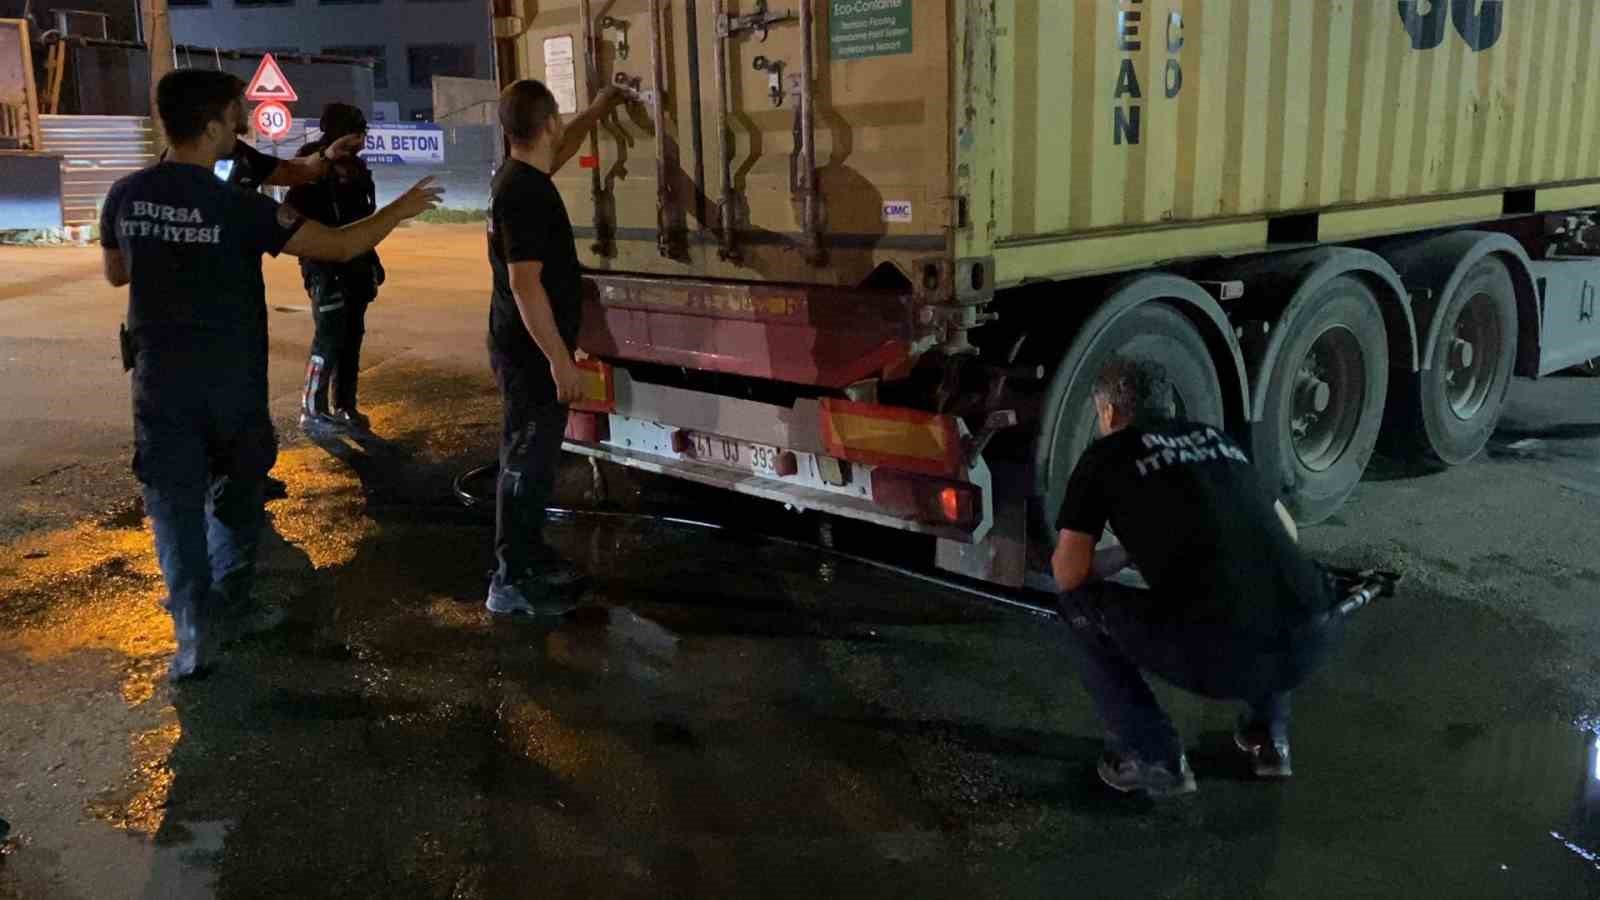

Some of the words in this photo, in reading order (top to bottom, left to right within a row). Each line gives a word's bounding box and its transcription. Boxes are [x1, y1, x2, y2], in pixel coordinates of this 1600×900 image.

[1113, 0, 1141, 145] EAN
[262, 111, 284, 128] 30
[364, 134, 386, 151] SA
[391, 135, 439, 151] BETON
[132, 200, 203, 223] BURSA
[884, 204, 909, 217] CIMC
